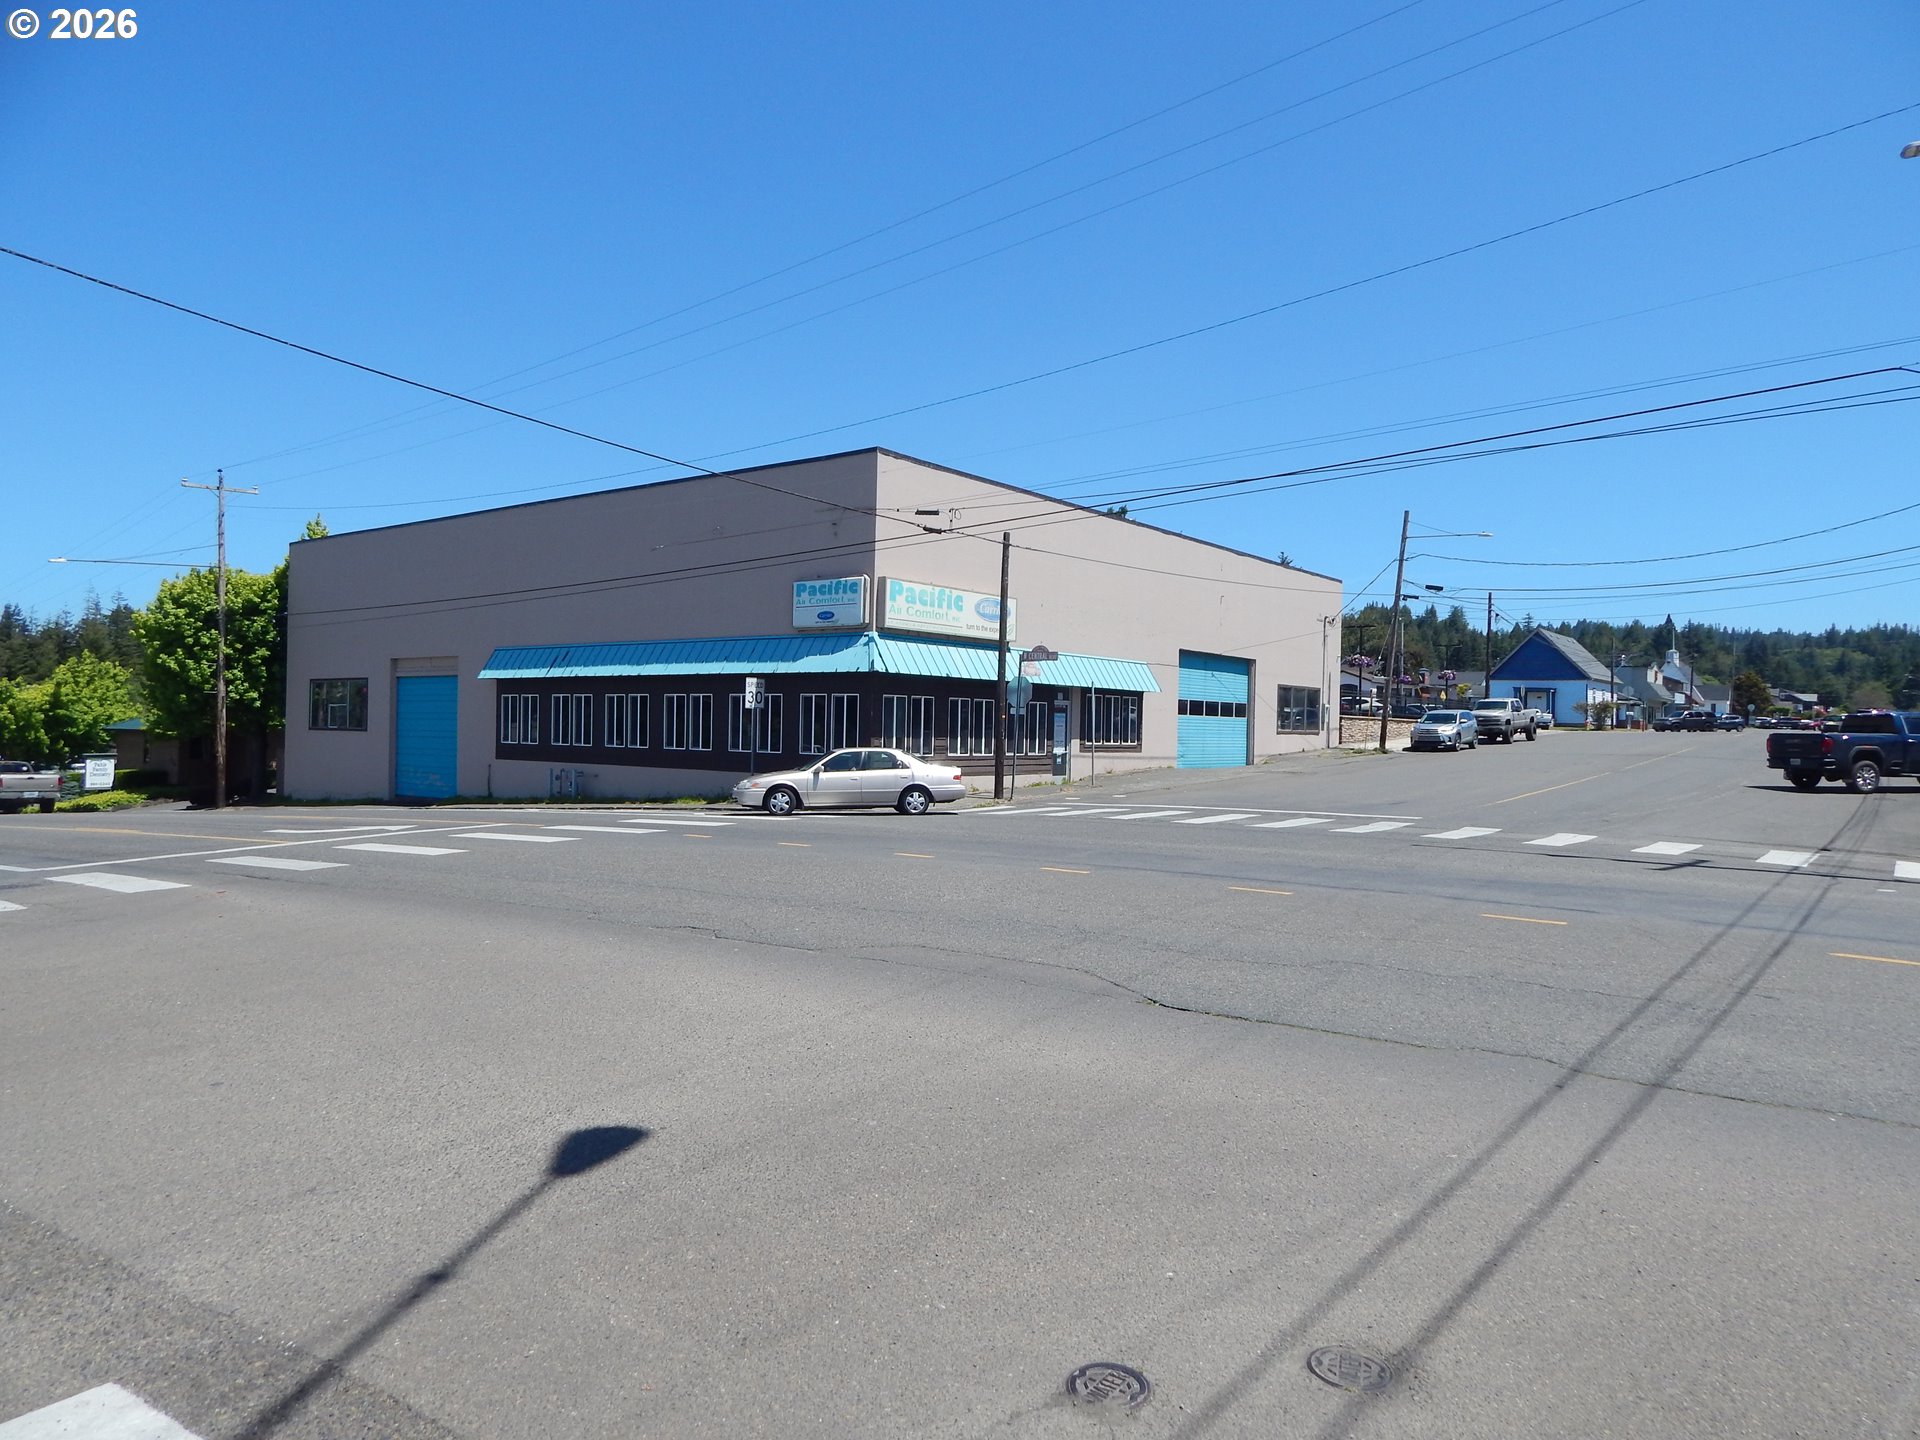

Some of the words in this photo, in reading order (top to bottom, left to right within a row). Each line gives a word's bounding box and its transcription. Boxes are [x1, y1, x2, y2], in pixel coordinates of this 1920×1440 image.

[796, 580, 858, 597] Pacific
[889, 580, 964, 612] Pacific
[747, 690, 763, 704] 30
